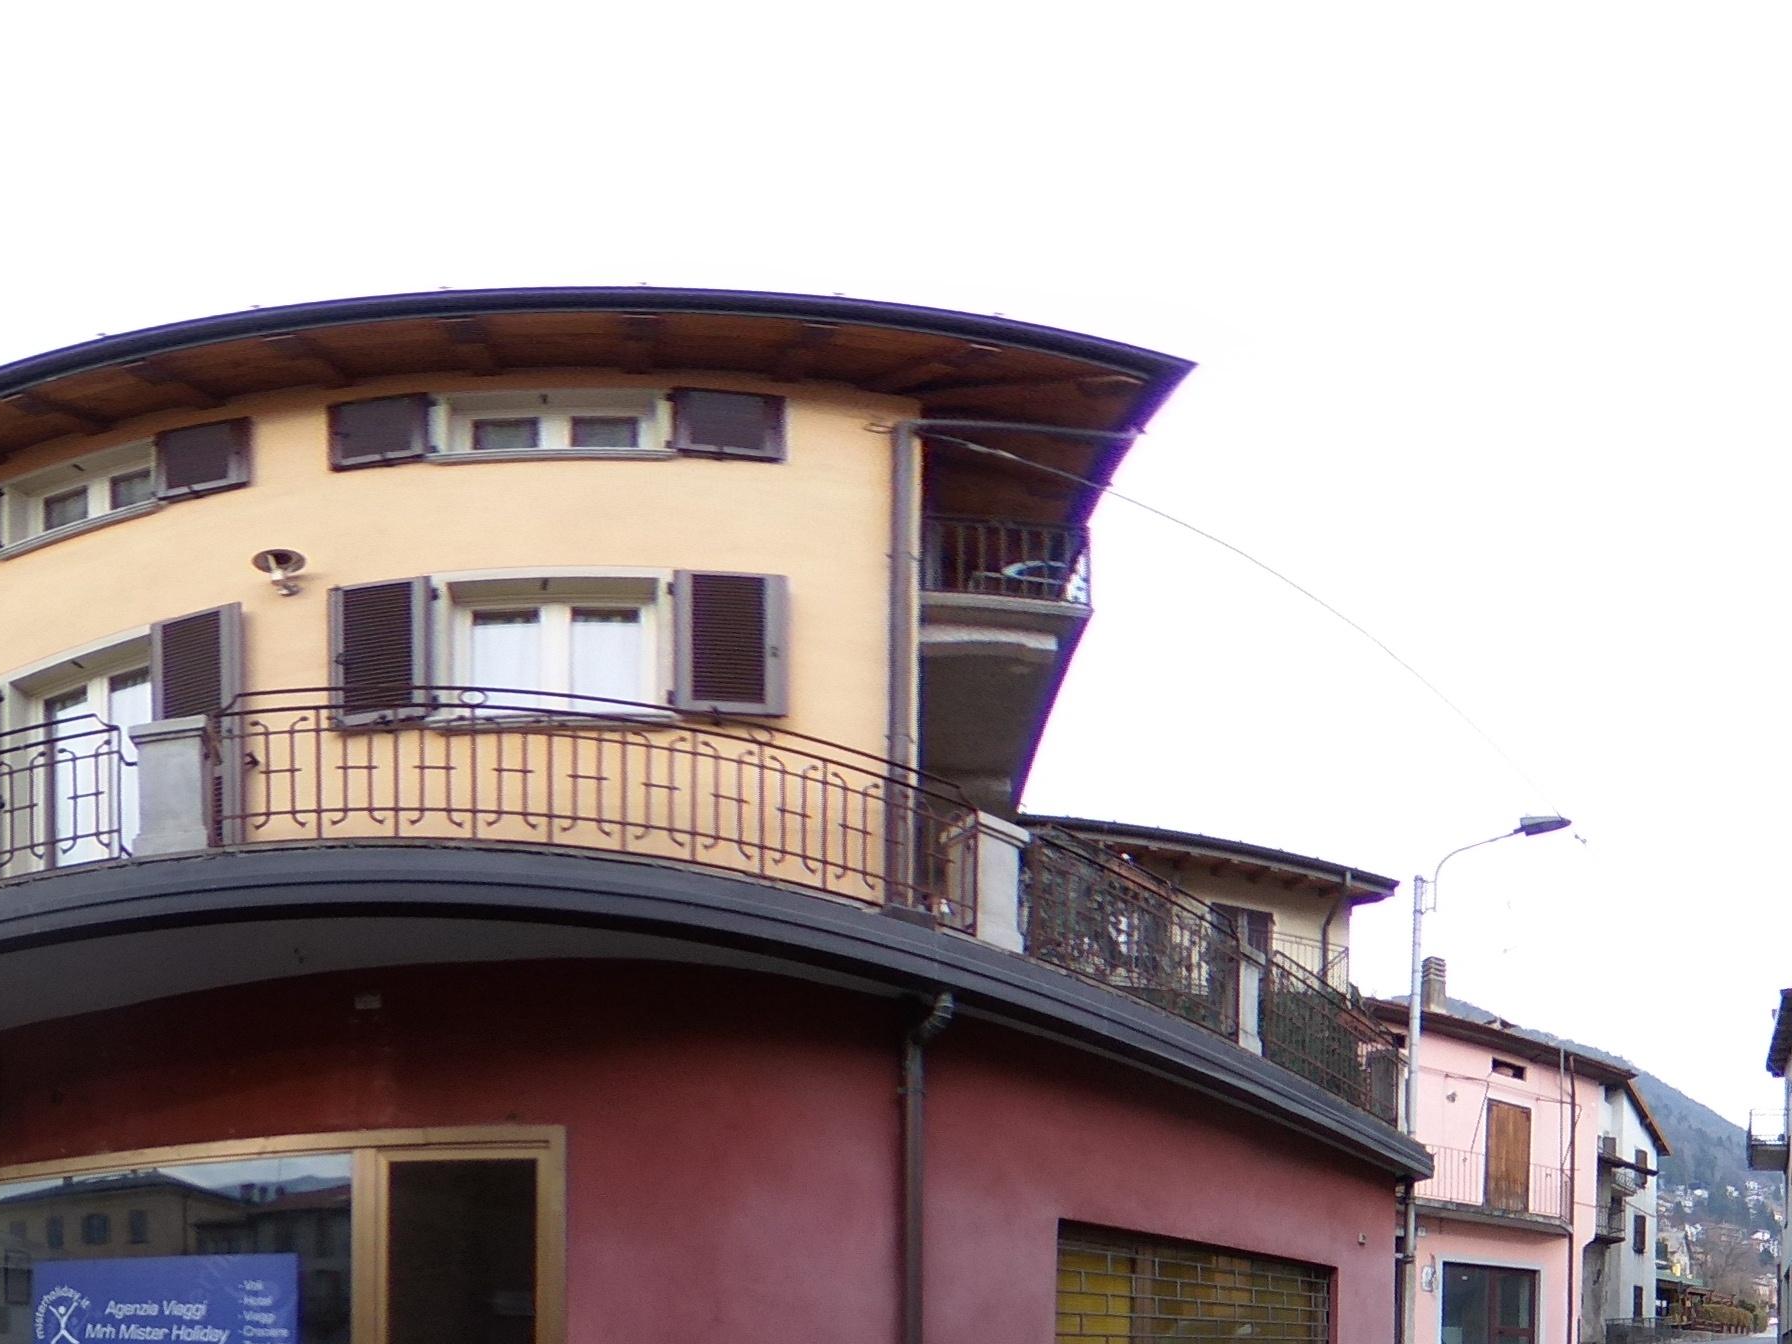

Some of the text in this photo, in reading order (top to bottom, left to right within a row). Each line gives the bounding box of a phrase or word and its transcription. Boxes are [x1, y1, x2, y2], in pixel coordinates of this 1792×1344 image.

[104, 1299, 208, 1320] Agenzia Viaggi
[85, 1323, 116, 1339] Mrh
[118, 1323, 169, 1341] Mister
